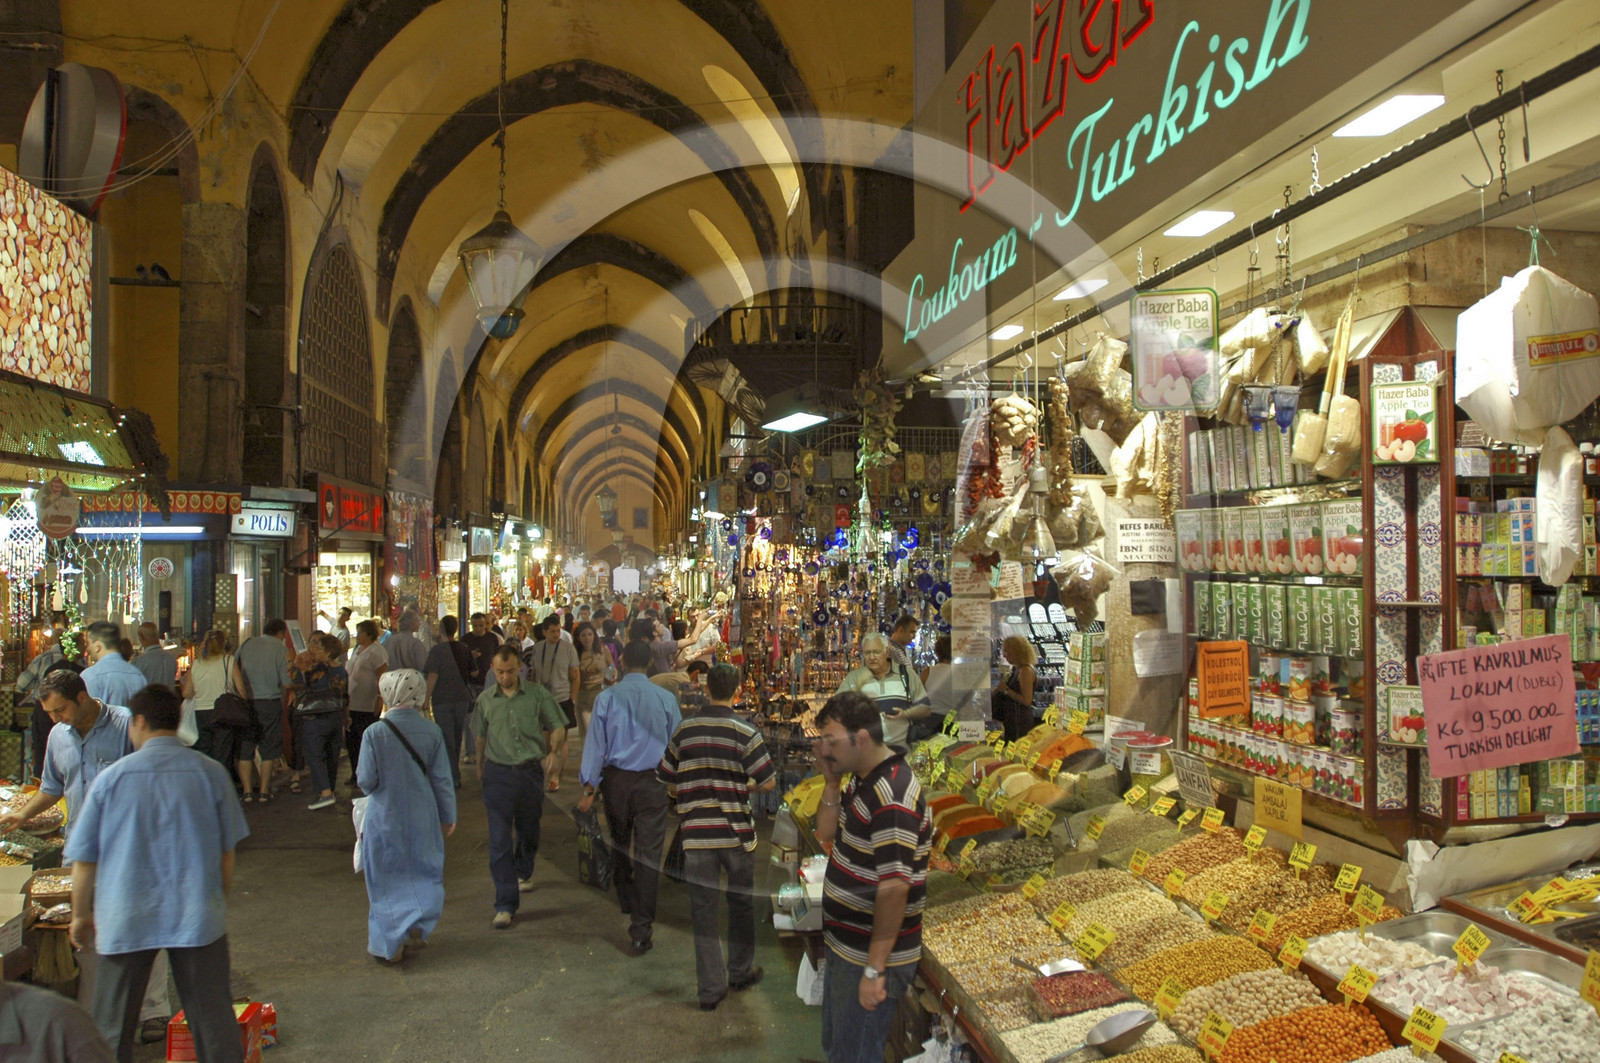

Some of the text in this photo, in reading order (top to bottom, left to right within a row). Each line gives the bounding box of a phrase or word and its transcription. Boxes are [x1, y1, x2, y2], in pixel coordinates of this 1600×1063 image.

[903, 227, 1017, 344] Loukoum
[1055, 0, 1310, 227] Turkish
[1140, 298, 1209, 314] Hazer Baba
[1185, 316, 1209, 329] Tea
[1378, 388, 1429, 400] Hazer Baba
[1379, 400, 1429, 411] Apple Tea
[1262, 511, 1280, 519] Hazer
[1291, 509, 1310, 518] Hazer
[1324, 505, 1345, 515] Hazer
[251, 513, 288, 533] POLİS
[1120, 523, 1141, 531] NEFES
[1265, 521, 1283, 530] Apple
[1293, 520, 1313, 528] Apple
[1325, 517, 1349, 527] Apple
[1298, 623, 1308, 650] Turkish
[1323, 625, 1333, 654] Turkish
[1349, 627, 1360, 657] Turkish
[1207, 658, 1242, 669] KOLESTROL
[1474, 645, 1562, 672] KAVRULMUŞ
[1450, 671, 1563, 701] LOKUM (DUBLE)
[1264, 783, 1285, 796] VAKUM
[1262, 794, 1288, 810] AMBALAJ
